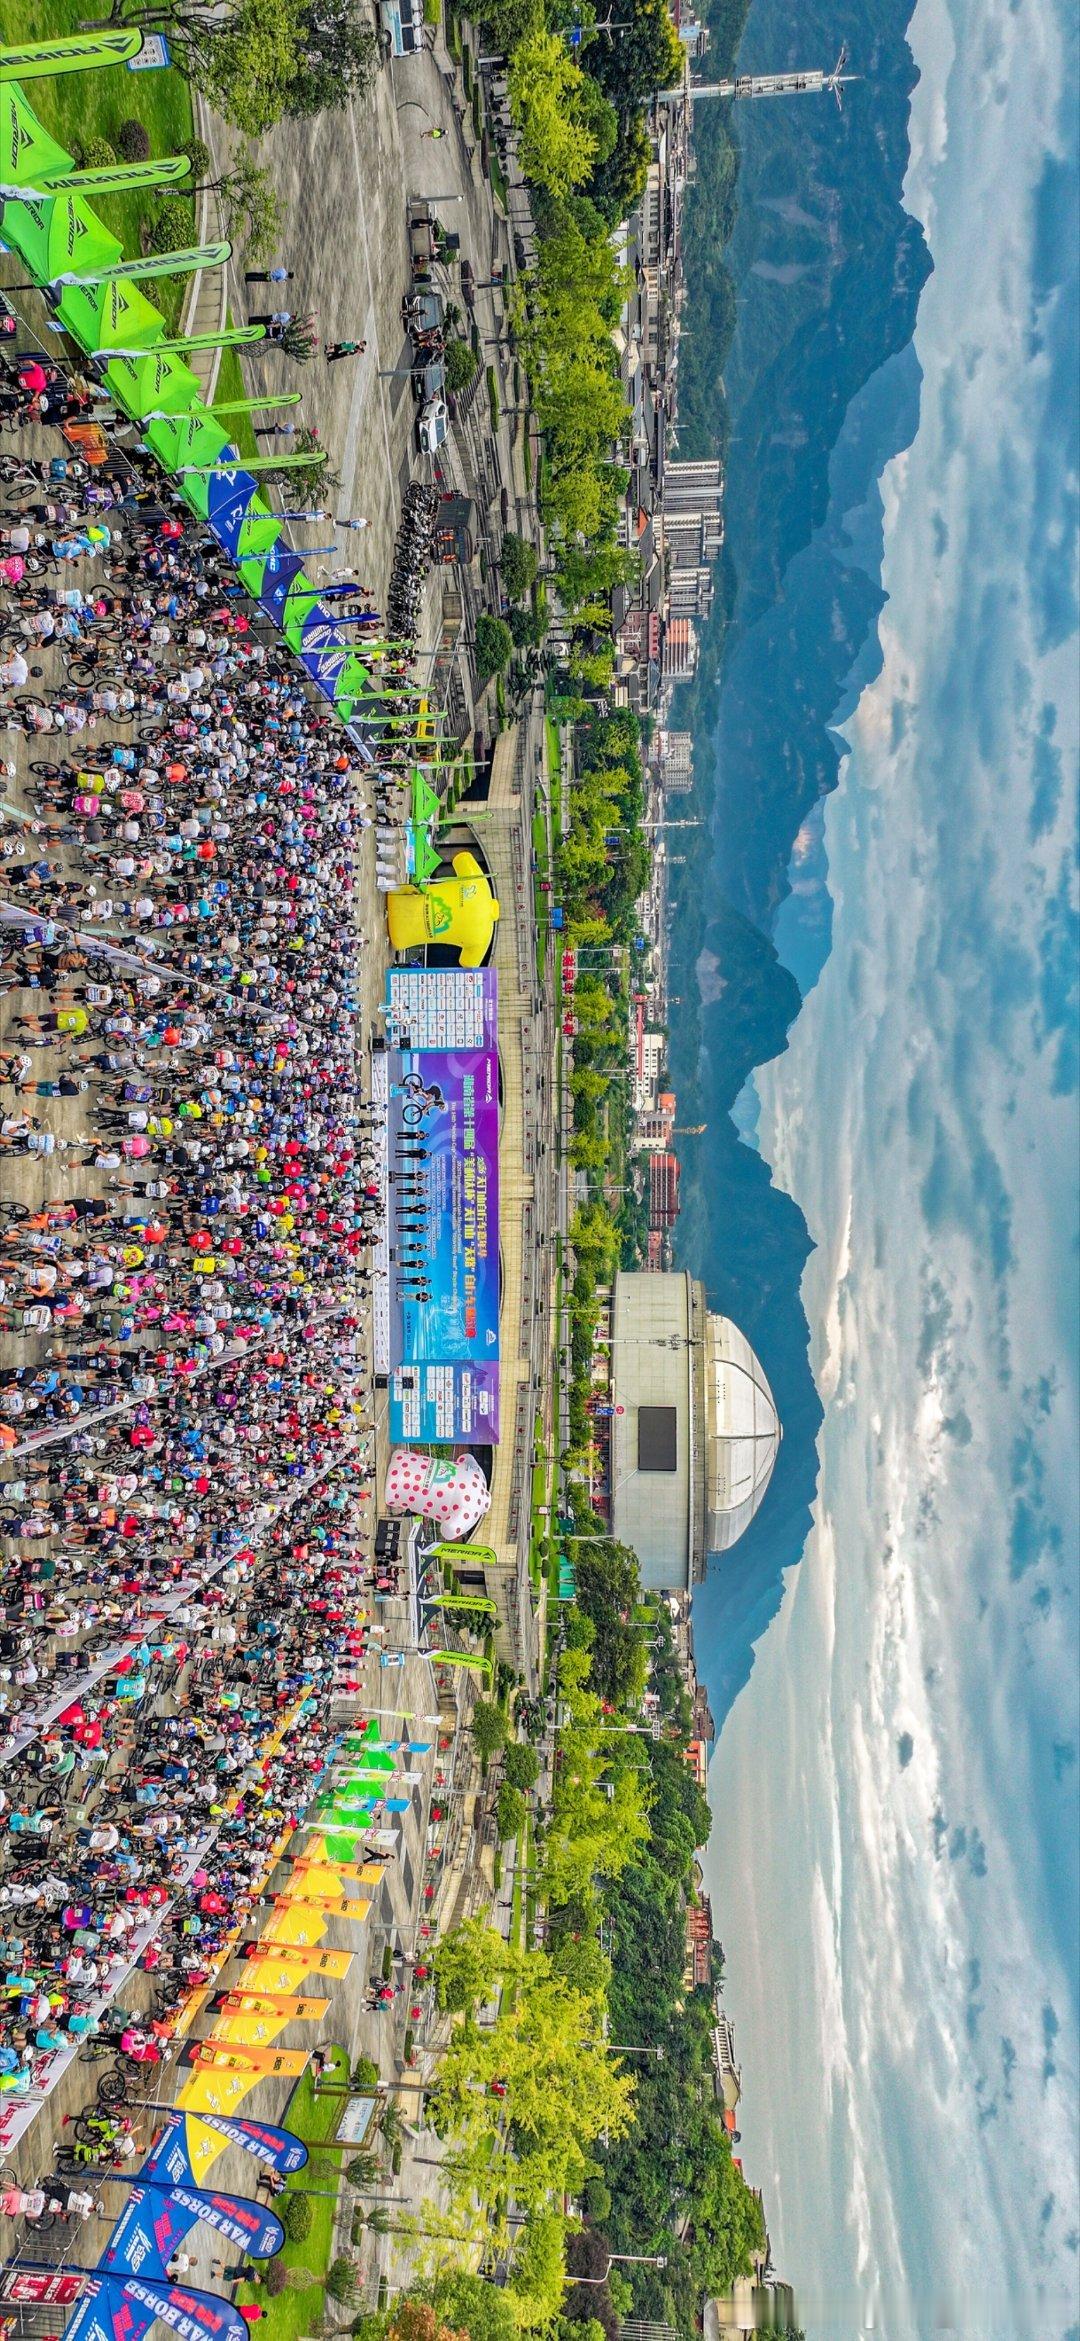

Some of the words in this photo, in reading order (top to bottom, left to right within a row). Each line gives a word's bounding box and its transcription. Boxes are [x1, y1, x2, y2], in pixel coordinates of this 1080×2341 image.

[10, 98, 20, 170] MERIDA
[22, 200, 45, 230] ERIDA
[121, 357, 138, 381] ERIDA
[154, 354, 162, 394] ERIDA
[246, 2140, 277, 2166] WAR
[218, 2218, 252, 2250] WAR
